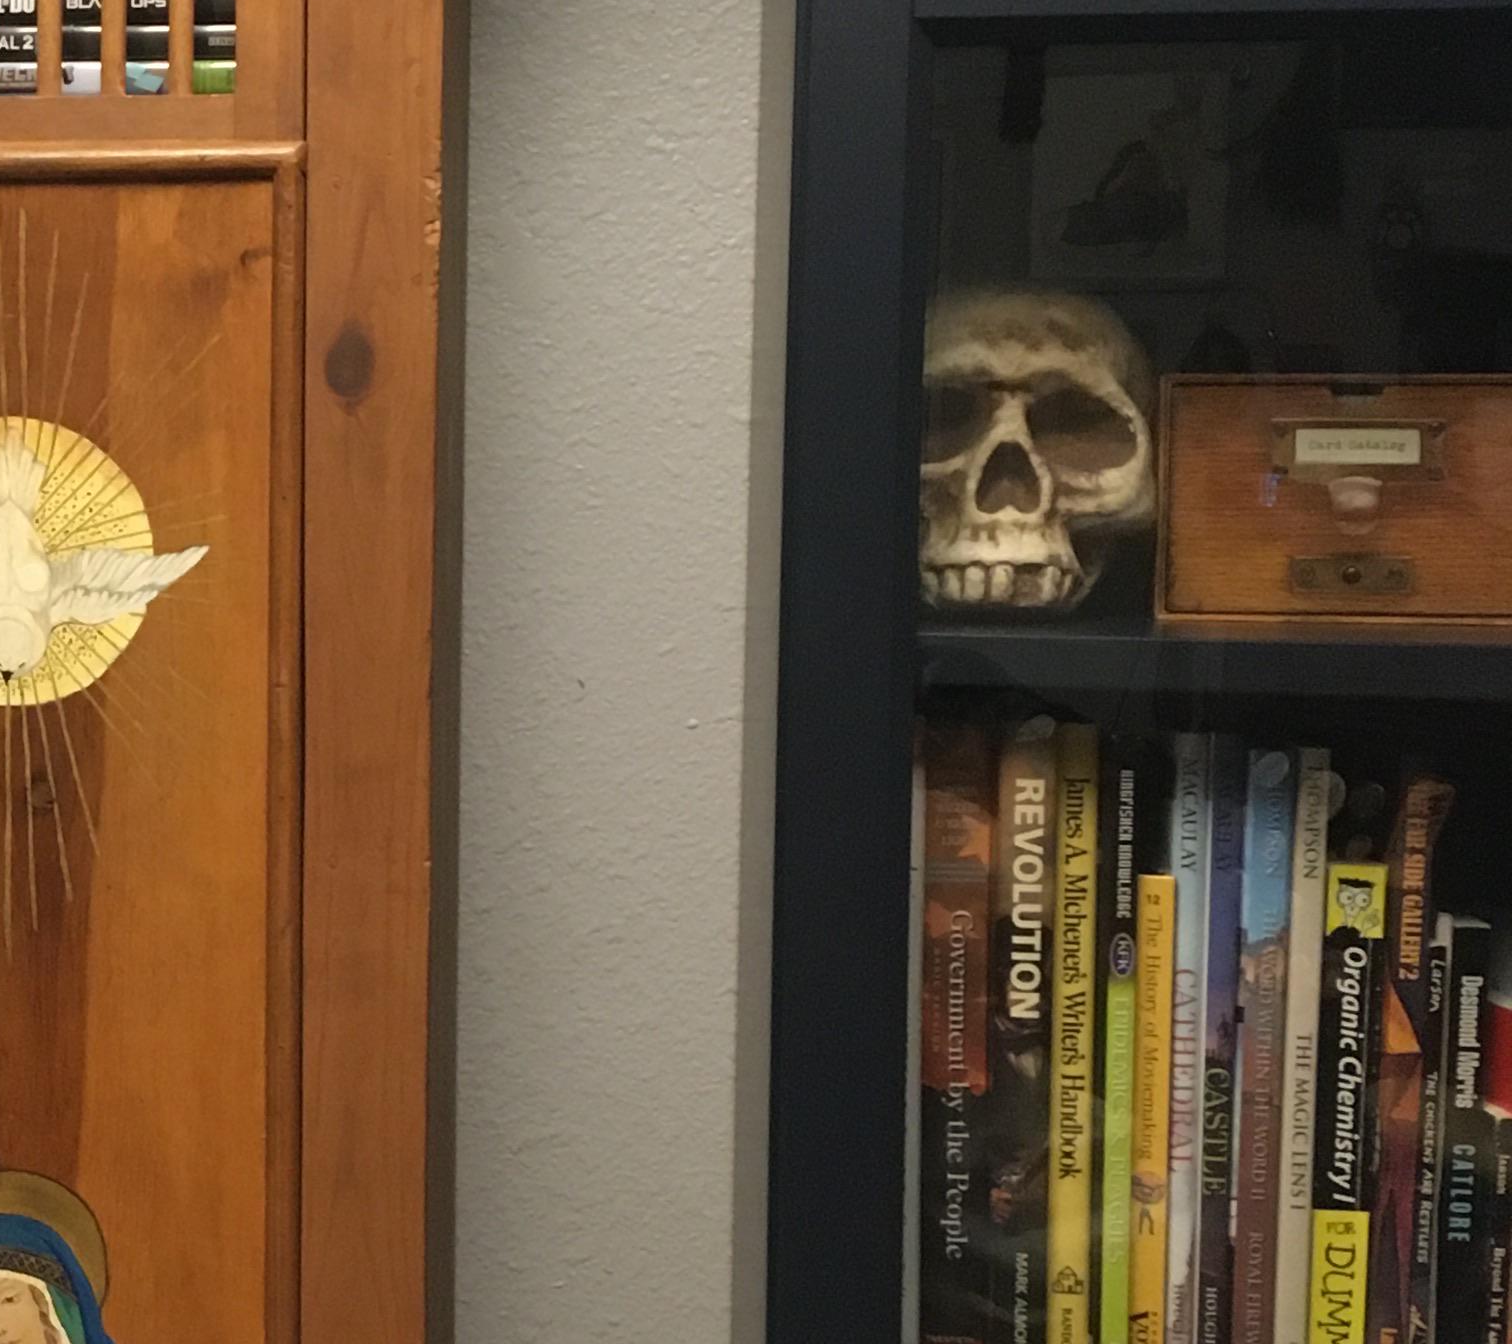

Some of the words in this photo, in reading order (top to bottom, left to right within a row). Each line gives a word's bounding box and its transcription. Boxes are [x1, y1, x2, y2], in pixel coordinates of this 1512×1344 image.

[22, 35, 34, 51] 2
[1307, 439, 1342, 451] Card
[1348, 439, 1407, 453] Catalog
[1064, 776, 1091, 839] James
[1118, 768, 1135, 841] KINGFISHER
[1180, 757, 1199, 873] MACAULAY
[1303, 765, 1325, 880] THOMPSON
[1065, 843, 1088, 865] A.
[1116, 843, 1134, 919] KNOWLEDGE
[1404, 853, 1425, 891] SIDE
[1007, 777, 1046, 1020] REVOLUTION
[1062, 873, 1089, 985] Michener's
[1147, 915, 1163, 948] The
[1399, 894, 1424, 967] GALLERY
[946, 909, 974, 1073] Government
[1143, 955, 1162, 1010] History
[1337, 946, 1368, 1051] Organic
[1398, 967, 1420, 981] 2
[1061, 990, 1086, 1066] Writer's
[1145, 1021, 1160, 1040] of
[1253, 1007, 1272, 1080] WITHIN
[1458, 975, 1484, 1049] Desmond
[1169, 968, 1197, 1174] CATHEDRAL
[1295, 1033, 1312, 1070] THE
[1454, 1051, 1482, 1109] Morris
[941, 1082, 972, 1112] by
[1057, 1073, 1086, 1180] Handbook
[1138, 1052, 1158, 1160] Moviemaking
[1253, 1085, 1269, 1121] THE
[1292, 1075, 1310, 1143] MAGIC
[1328, 1056, 1364, 1186] Chemistry
[944, 1119, 971, 1163] the
[1202, 1067, 1231, 1196] CASTLE
[1251, 1124, 1267, 1184] WORD
[1291, 1150, 1309, 1198] LENS
[1446, 1143, 1477, 1243] CATLORE
[939, 1171, 971, 1260] People
[1015, 1252, 1029, 1294] MARK
[1247, 1231, 1265, 1284] ROYAL
[1490, 1246, 1507, 1292] Beyond
